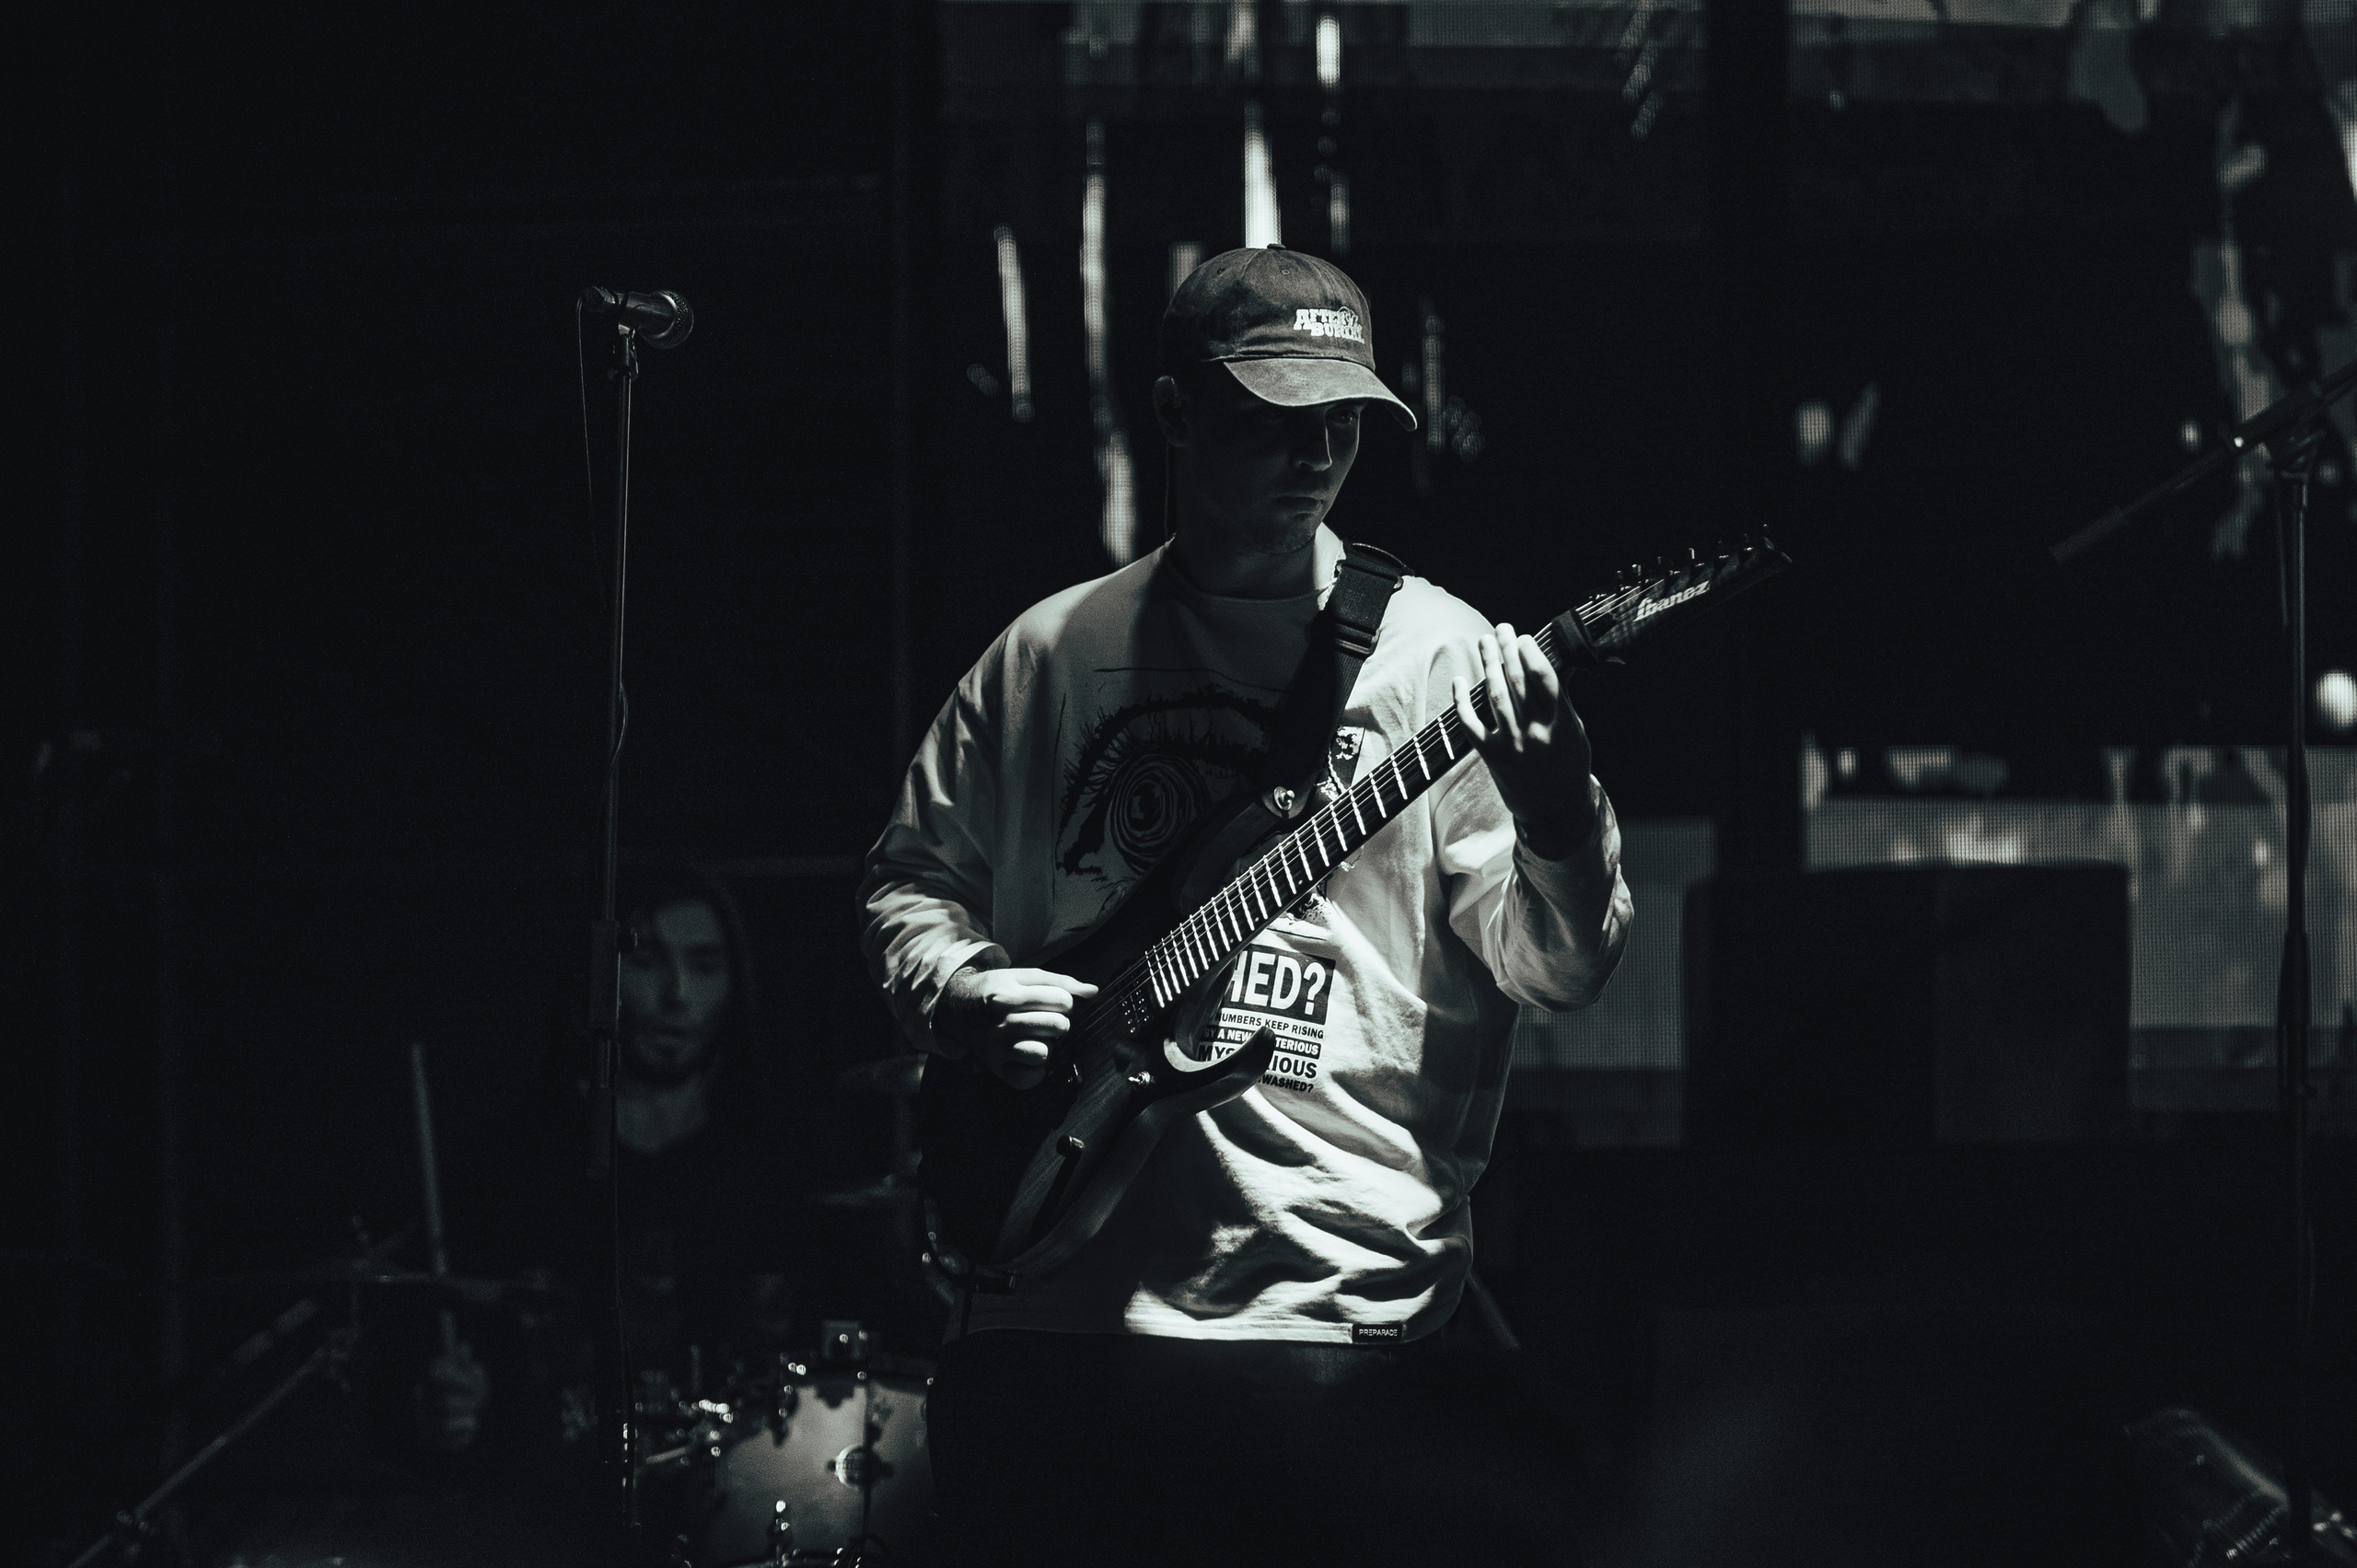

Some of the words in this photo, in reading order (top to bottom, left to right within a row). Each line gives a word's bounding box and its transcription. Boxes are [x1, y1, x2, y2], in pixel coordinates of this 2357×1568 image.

[1633, 580, 1710, 621] Ibanez
[1215, 1013, 1262, 1027] NUMBERS
[1265, 1018, 1289, 1030] KEEP
[1292, 1025, 1324, 1040] RISING
[1217, 1028, 1225, 1040] A
[1226, 1029, 1253, 1042] NEW
[1275, 1037, 1319, 1056] TERIOUS
[1258, 1074, 1314, 1094] WASHED?
[1358, 1329, 1398, 1337] PREPARADE
